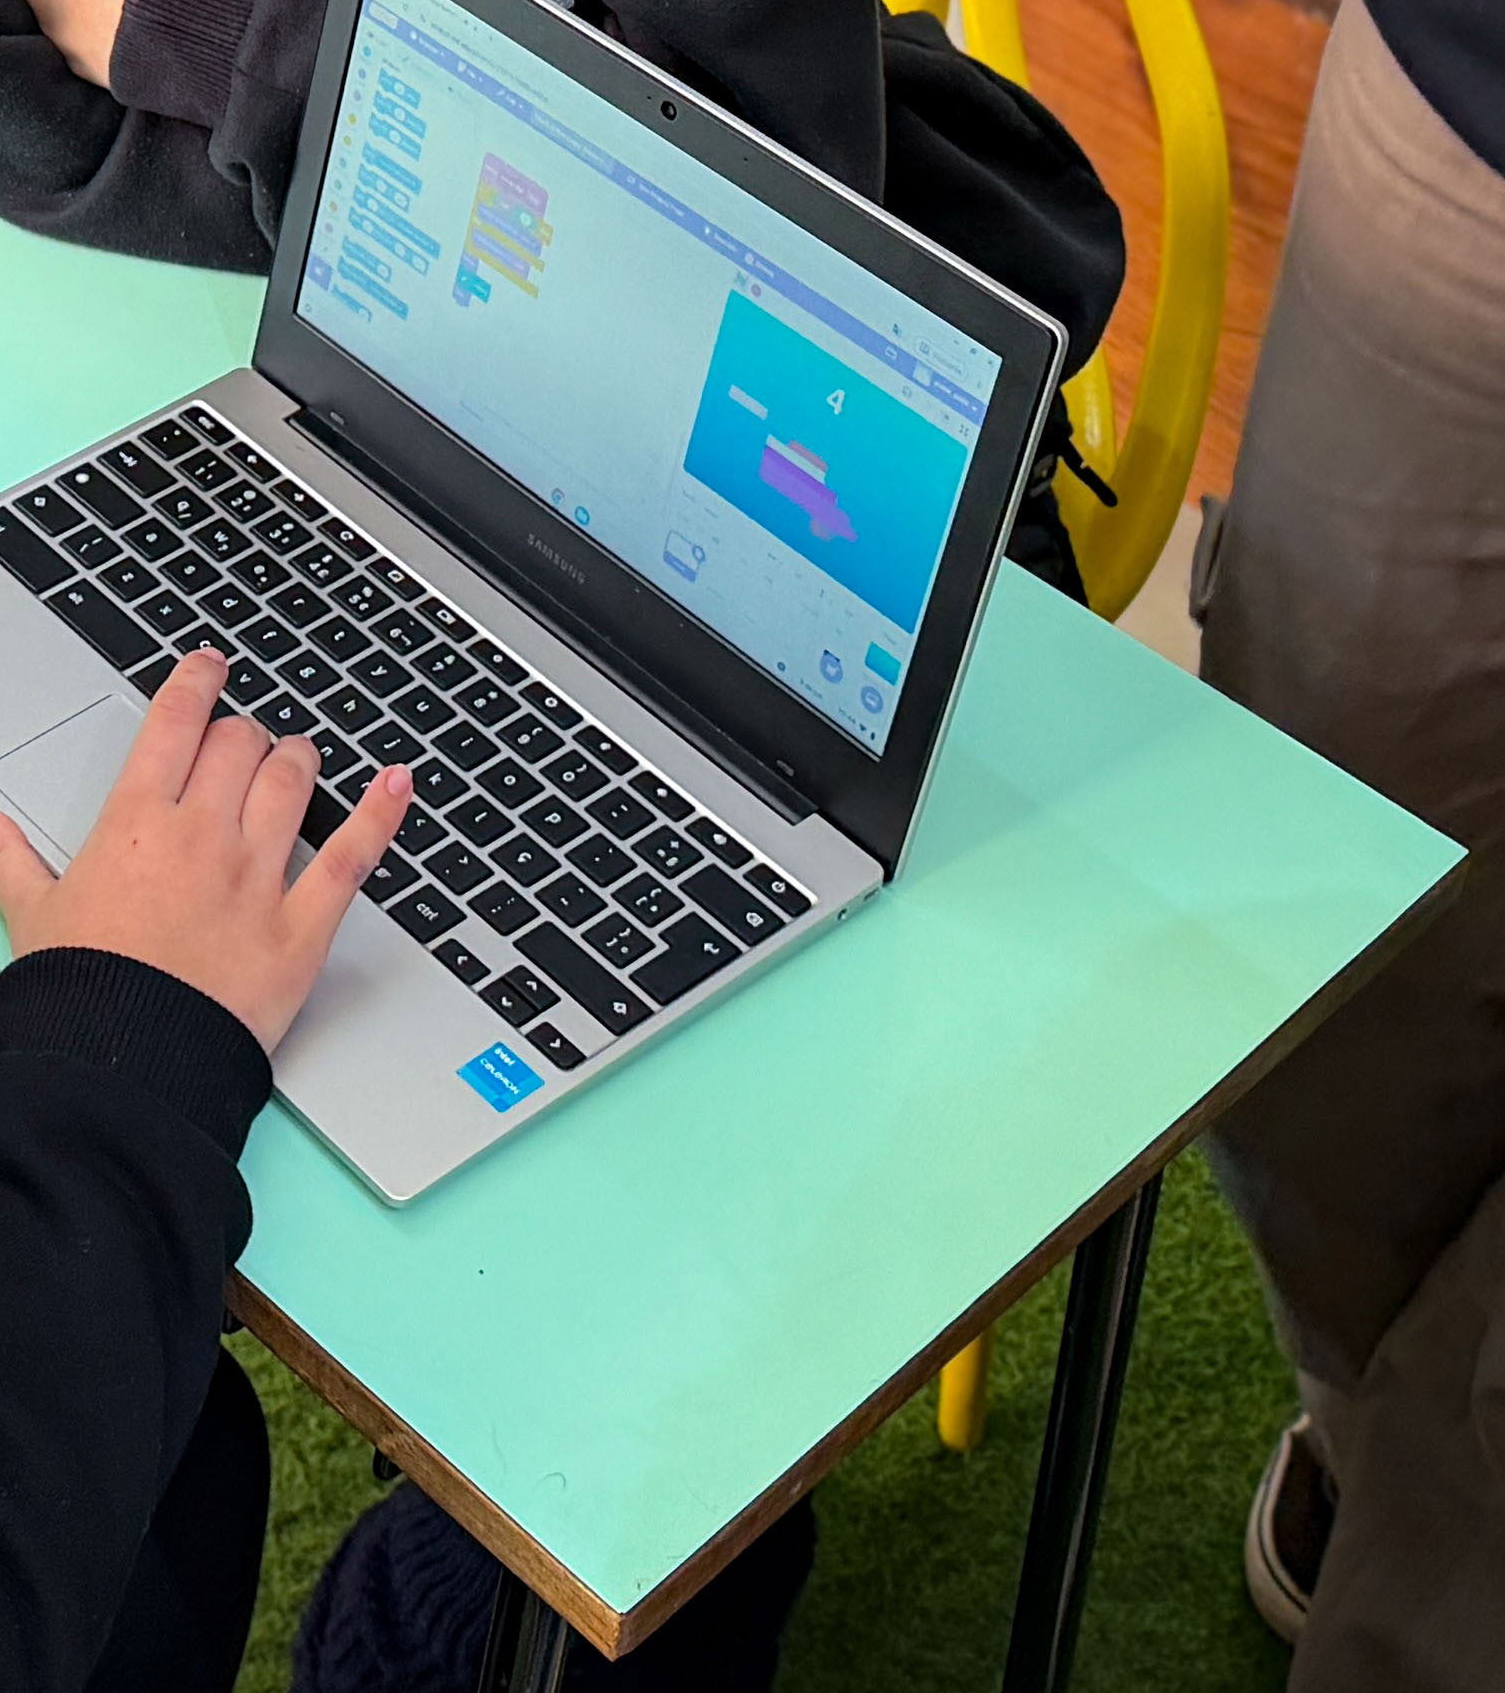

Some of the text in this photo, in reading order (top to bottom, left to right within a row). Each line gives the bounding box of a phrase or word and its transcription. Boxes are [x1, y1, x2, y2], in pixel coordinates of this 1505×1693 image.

[826, 389, 845, 415] 4
[527, 533, 586, 584] SAMSUNG
[222, 598, 239, 609] d
[262, 630, 278, 640] f
[299, 666, 316, 679] g
[370, 665, 388, 676] y
[342, 699, 356, 713] h
[416, 701, 430, 713] u
[278, 706, 292, 720] b
[383, 738, 402, 750] j
[320, 746, 334, 757] n
[428, 772, 442, 786] k
[416, 902, 439, 921] ctrl
[494, 1048, 516, 1066] intel
